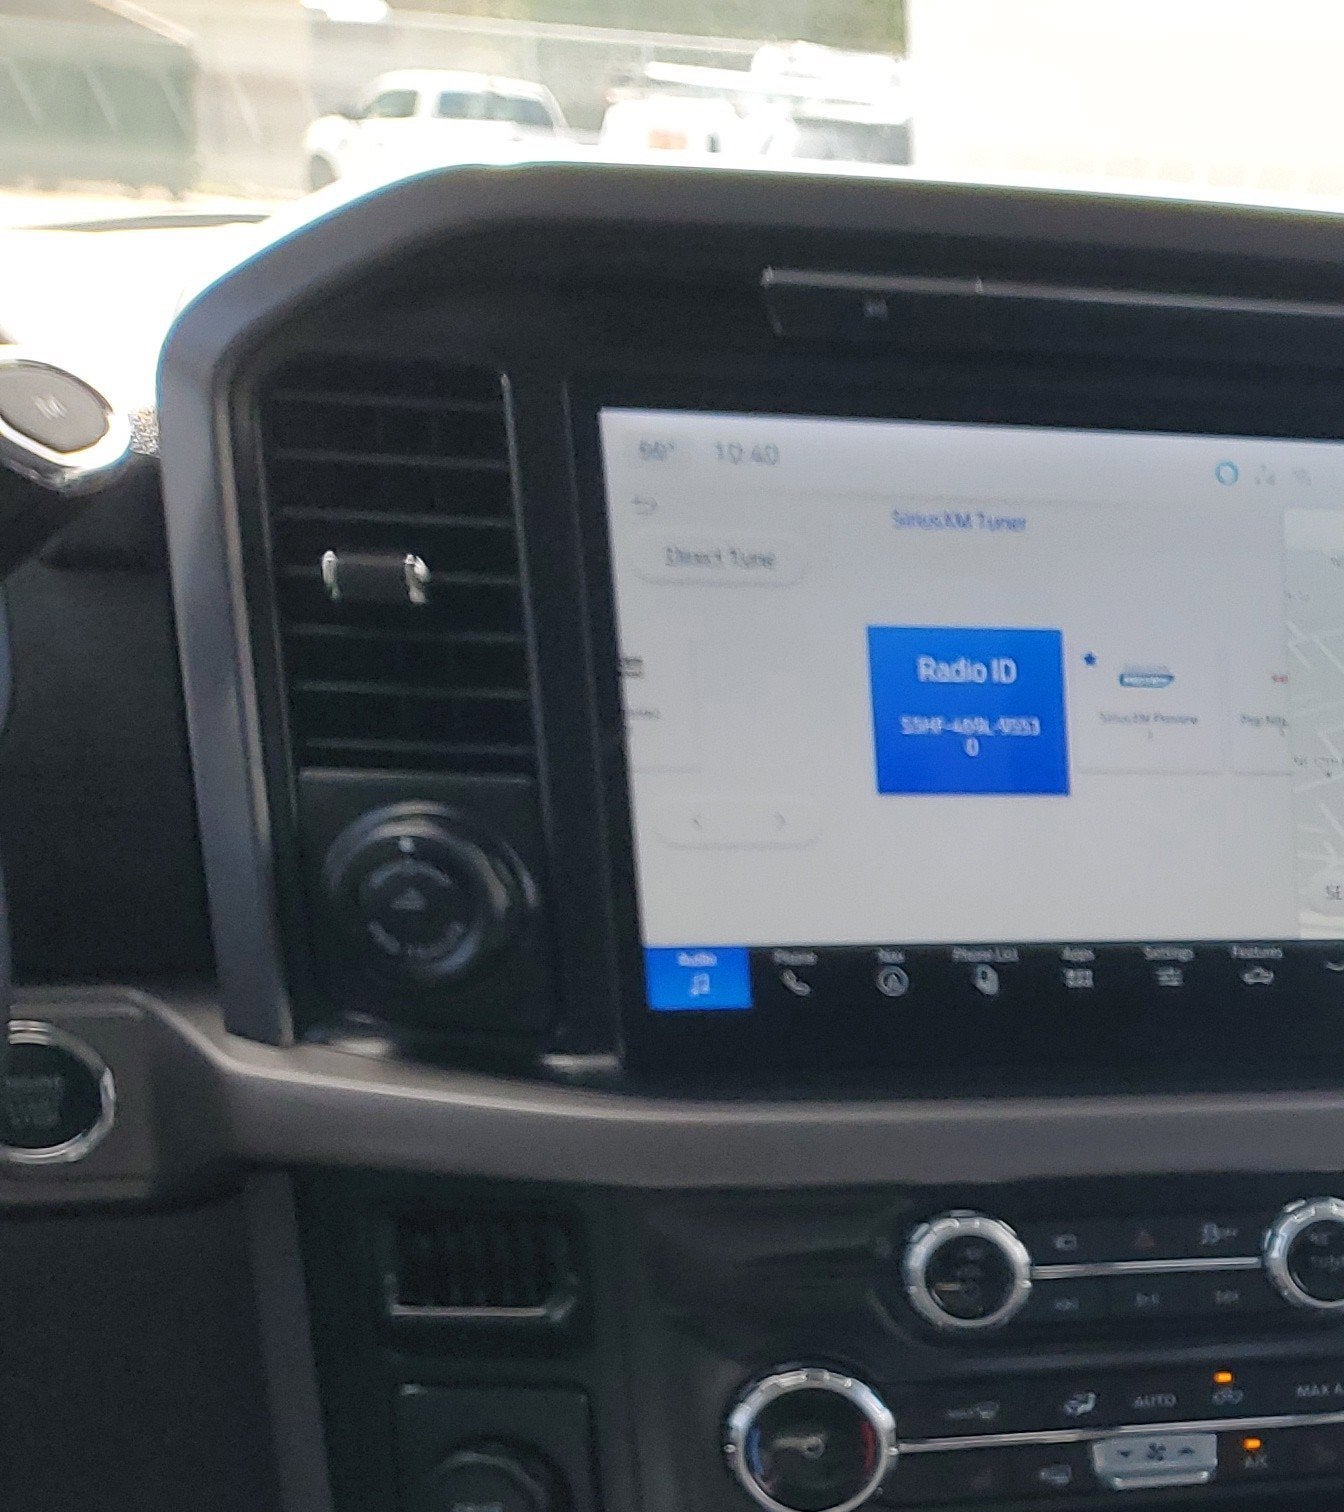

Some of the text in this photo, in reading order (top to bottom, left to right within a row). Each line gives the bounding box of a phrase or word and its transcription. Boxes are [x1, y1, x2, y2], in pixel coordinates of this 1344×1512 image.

[916, 656, 1018, 685] Radio ID
[1296, 1384, 1332, 1399] MAX
[1133, 1393, 1177, 1408] AUTO
